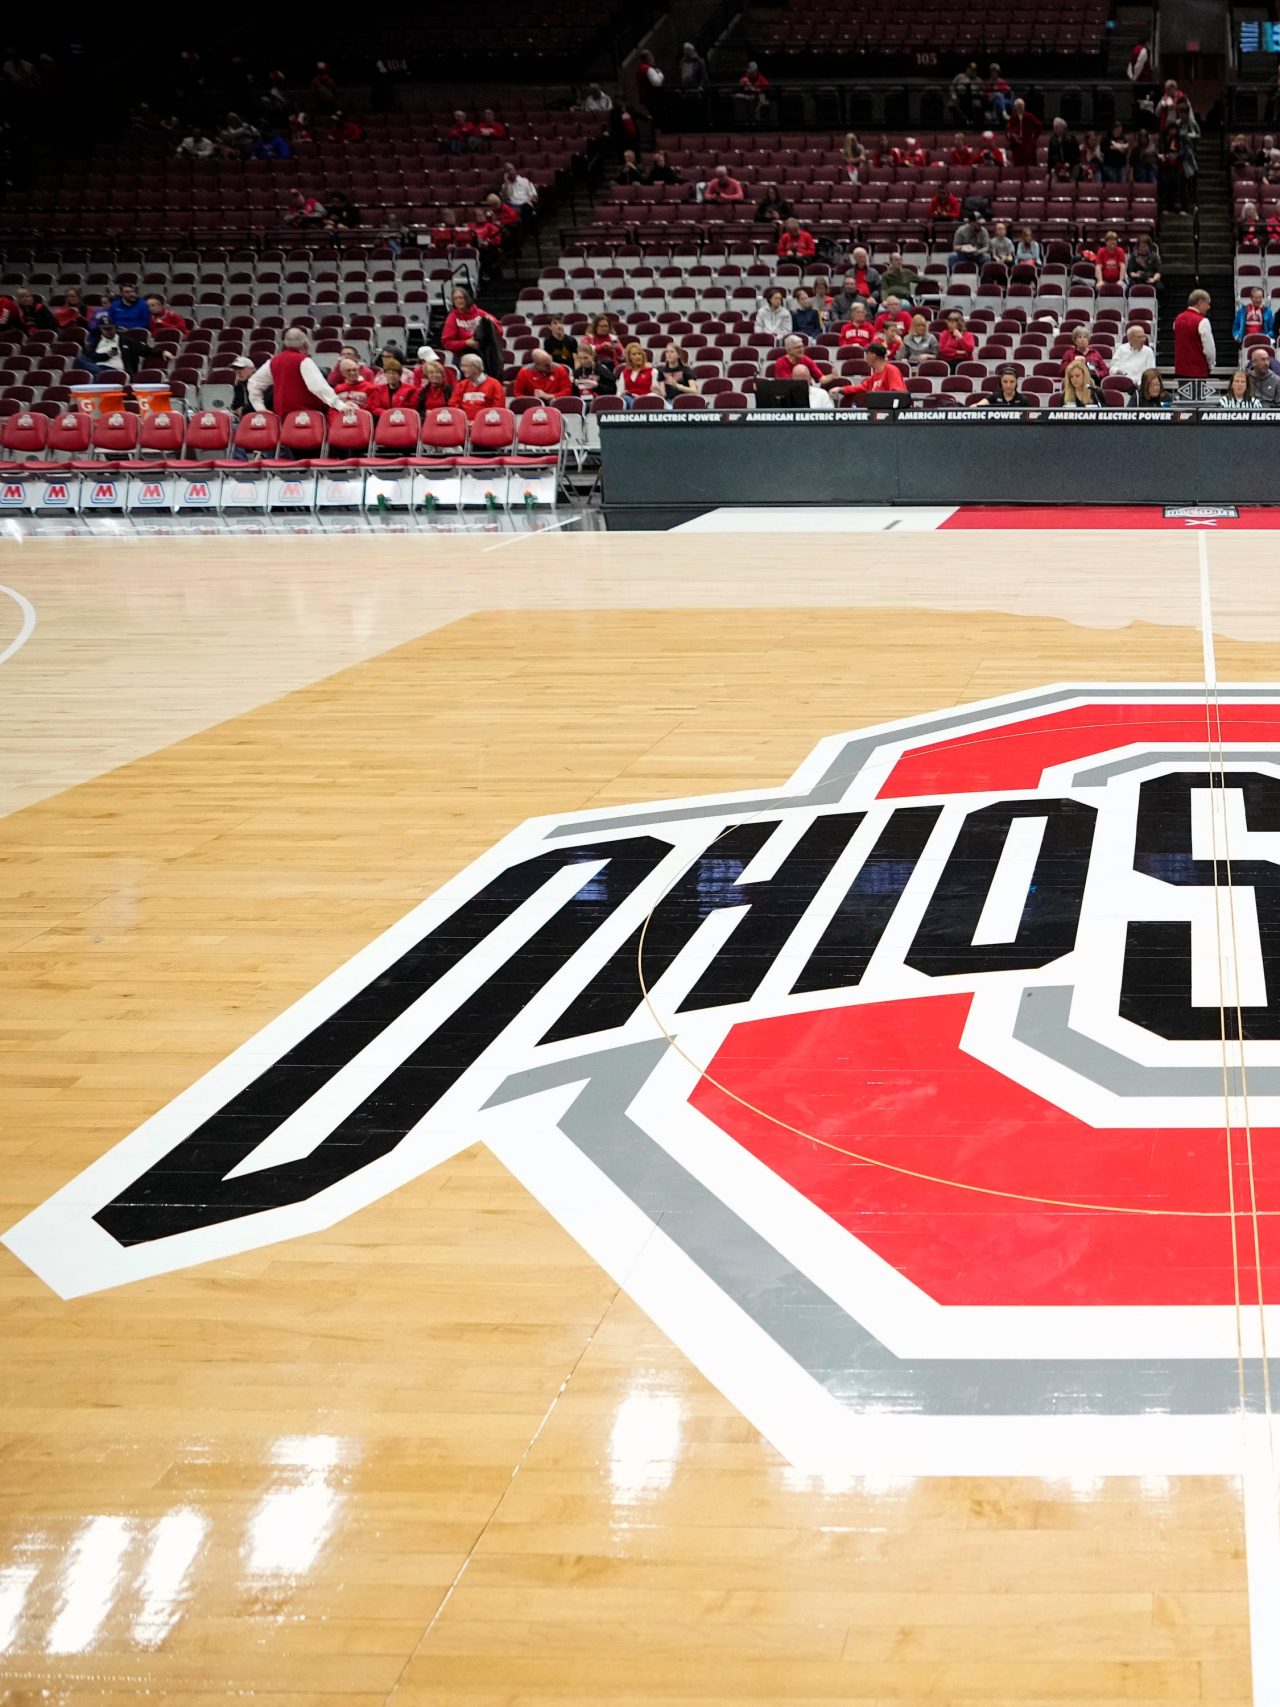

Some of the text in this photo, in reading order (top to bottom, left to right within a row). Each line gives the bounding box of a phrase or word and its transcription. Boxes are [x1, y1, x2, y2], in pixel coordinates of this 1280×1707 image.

[915, 53, 937, 64] 105
[600, 413, 721, 422] AMERICAN ELECTRIC POWER
[746, 412, 868, 421] AMERICAN ELECTRIC POWER
[898, 411, 1021, 420] AMERICAN ELECTRIC POWER
[1048, 411, 1172, 420] AMERICAN ELECTRIC POWER
[1201, 412, 1249, 420] AMERICAN
[92, 798, 1098, 1248] OHIO
